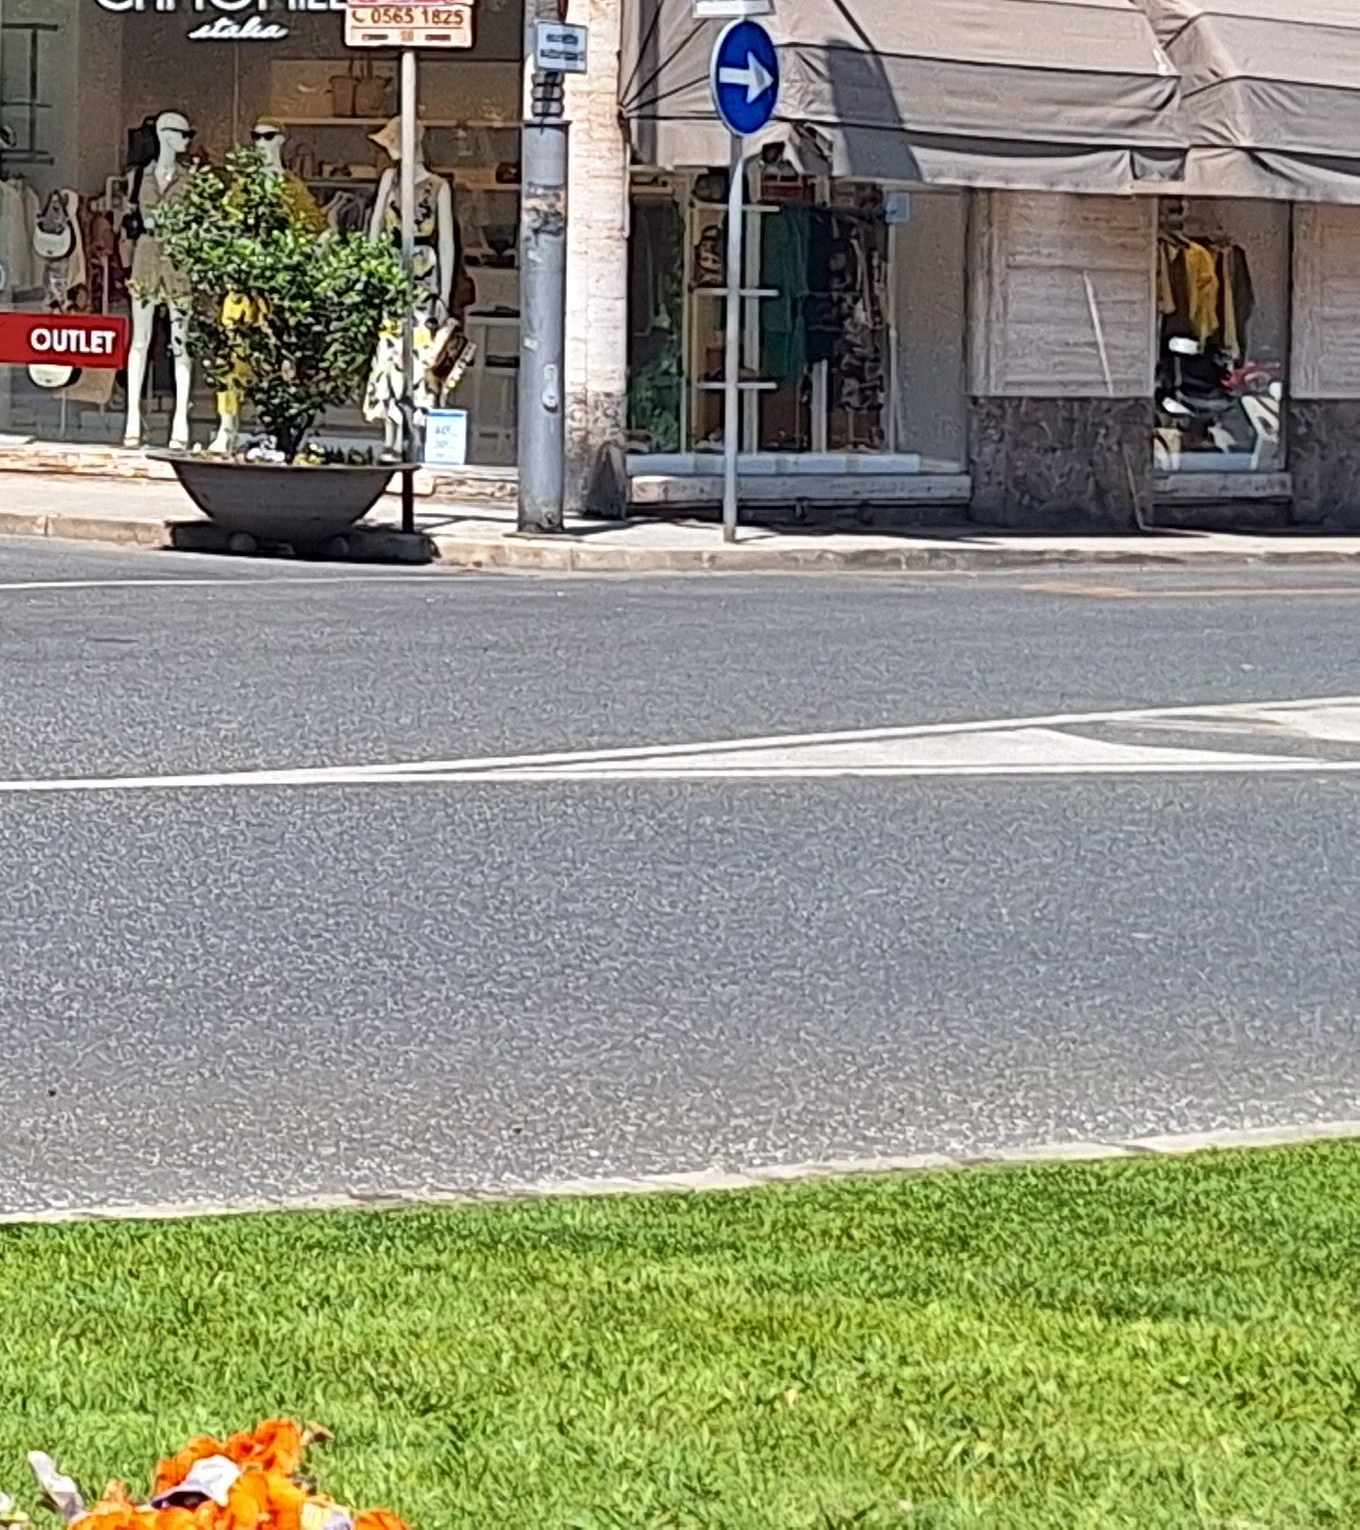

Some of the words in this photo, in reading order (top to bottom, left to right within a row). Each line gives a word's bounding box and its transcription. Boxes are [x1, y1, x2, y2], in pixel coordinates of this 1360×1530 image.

[370, 8, 415, 24] 0565
[421, 9, 464, 25] 1825
[30, 328, 117, 354] OUTLET
